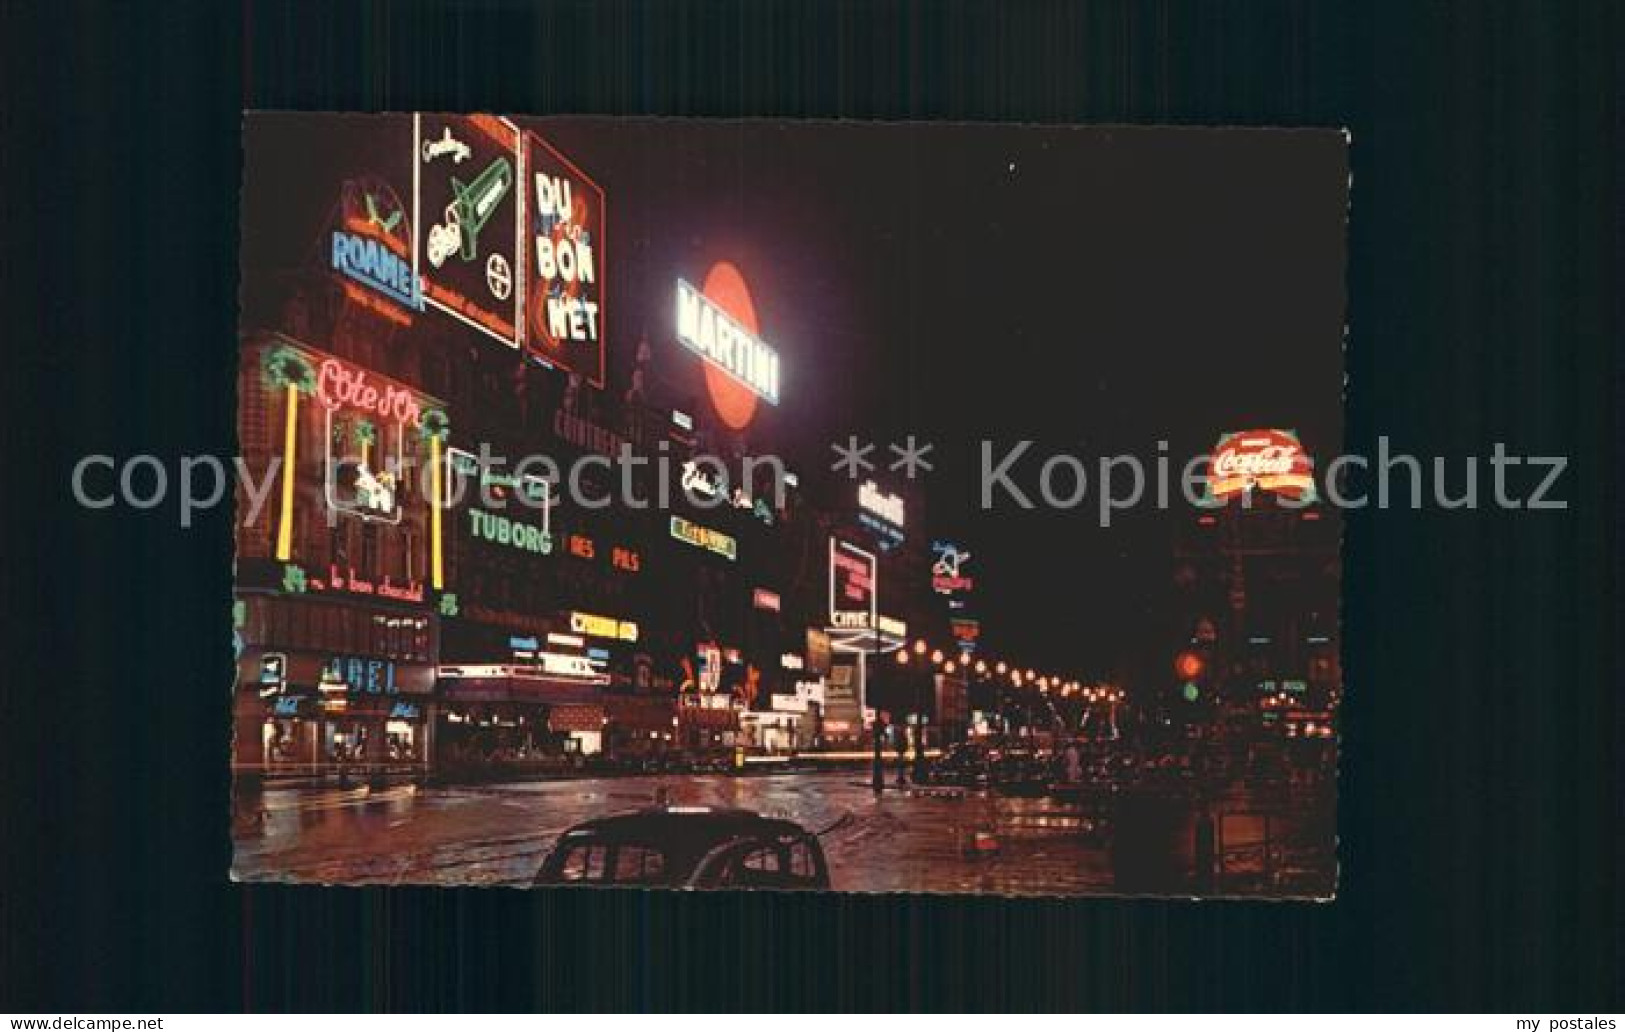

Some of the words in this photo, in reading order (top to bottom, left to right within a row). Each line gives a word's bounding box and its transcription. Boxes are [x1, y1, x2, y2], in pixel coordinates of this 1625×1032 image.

[534, 171, 572, 222] DU
[535, 235, 596, 283] BON
[546, 297, 599, 341] NET
[677, 284, 779, 400] MARTINI
[468, 507, 553, 556] TUBORG
